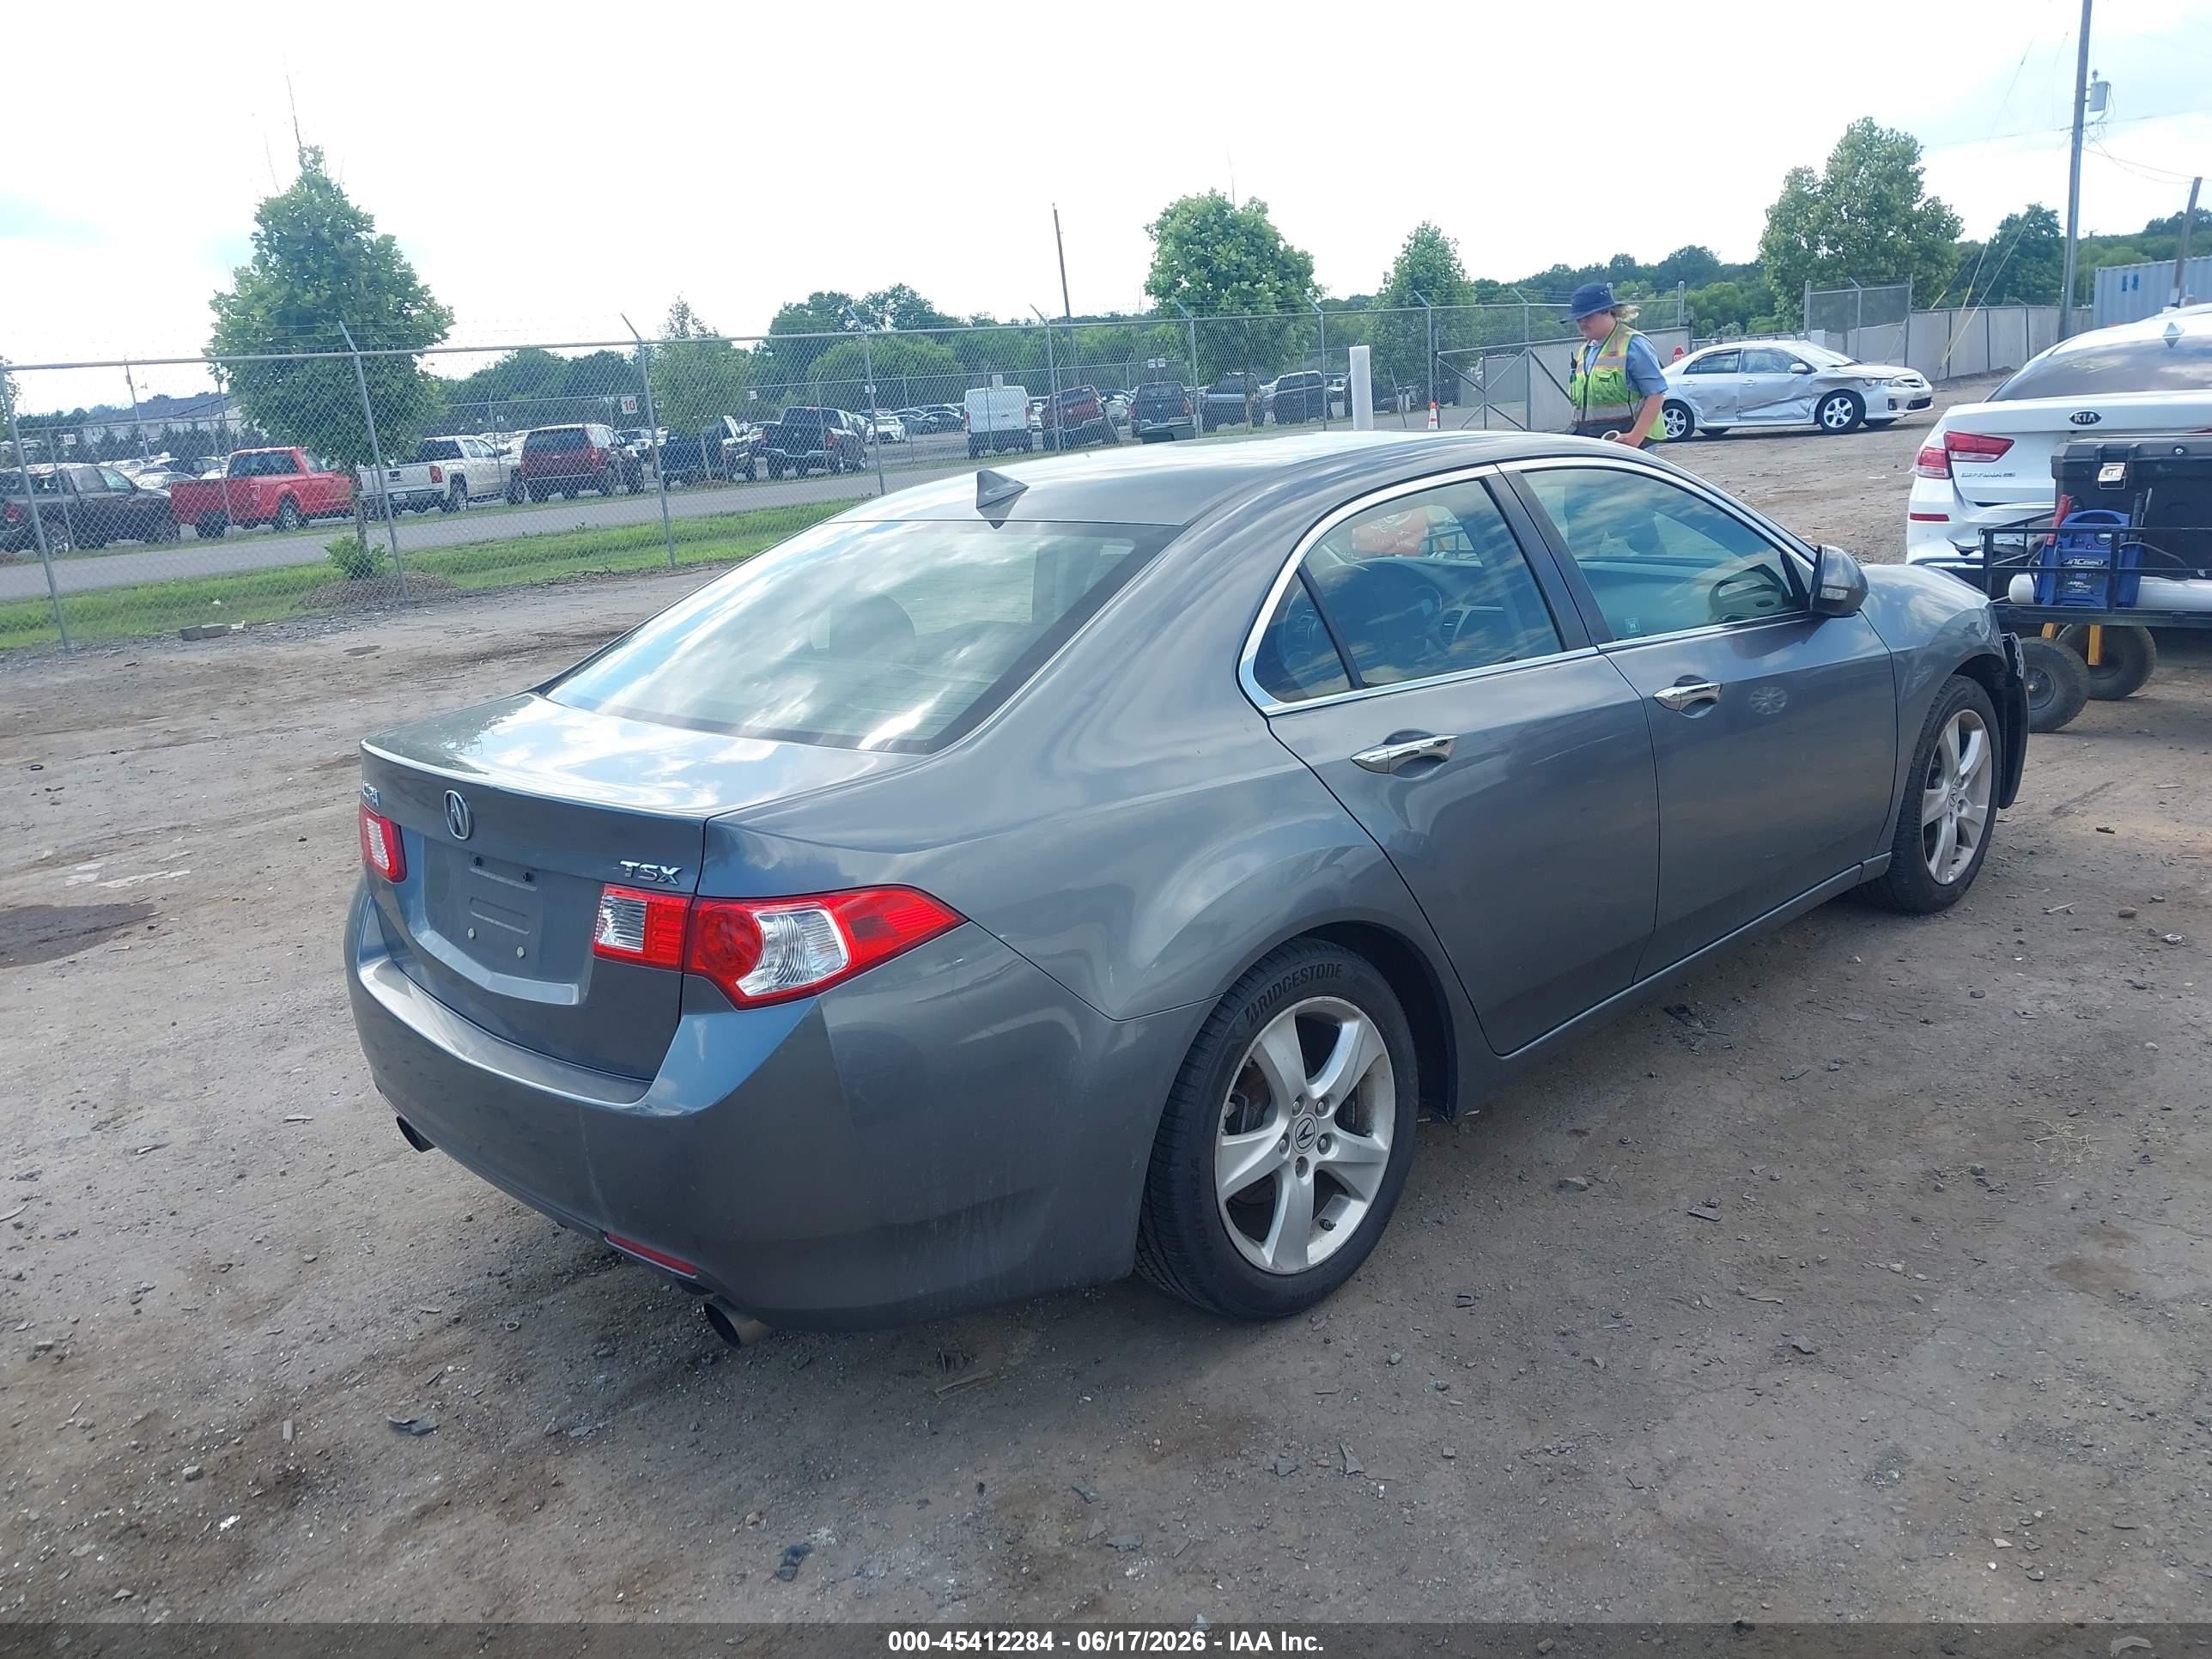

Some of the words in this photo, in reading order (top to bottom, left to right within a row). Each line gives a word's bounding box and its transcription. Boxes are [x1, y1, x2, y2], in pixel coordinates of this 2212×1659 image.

[623, 399, 635, 410] 10
[2074, 413, 2096, 422] KIA
[619, 860, 683, 885] TSX
[1244, 963, 1343, 1028] BRIDGESTONE
